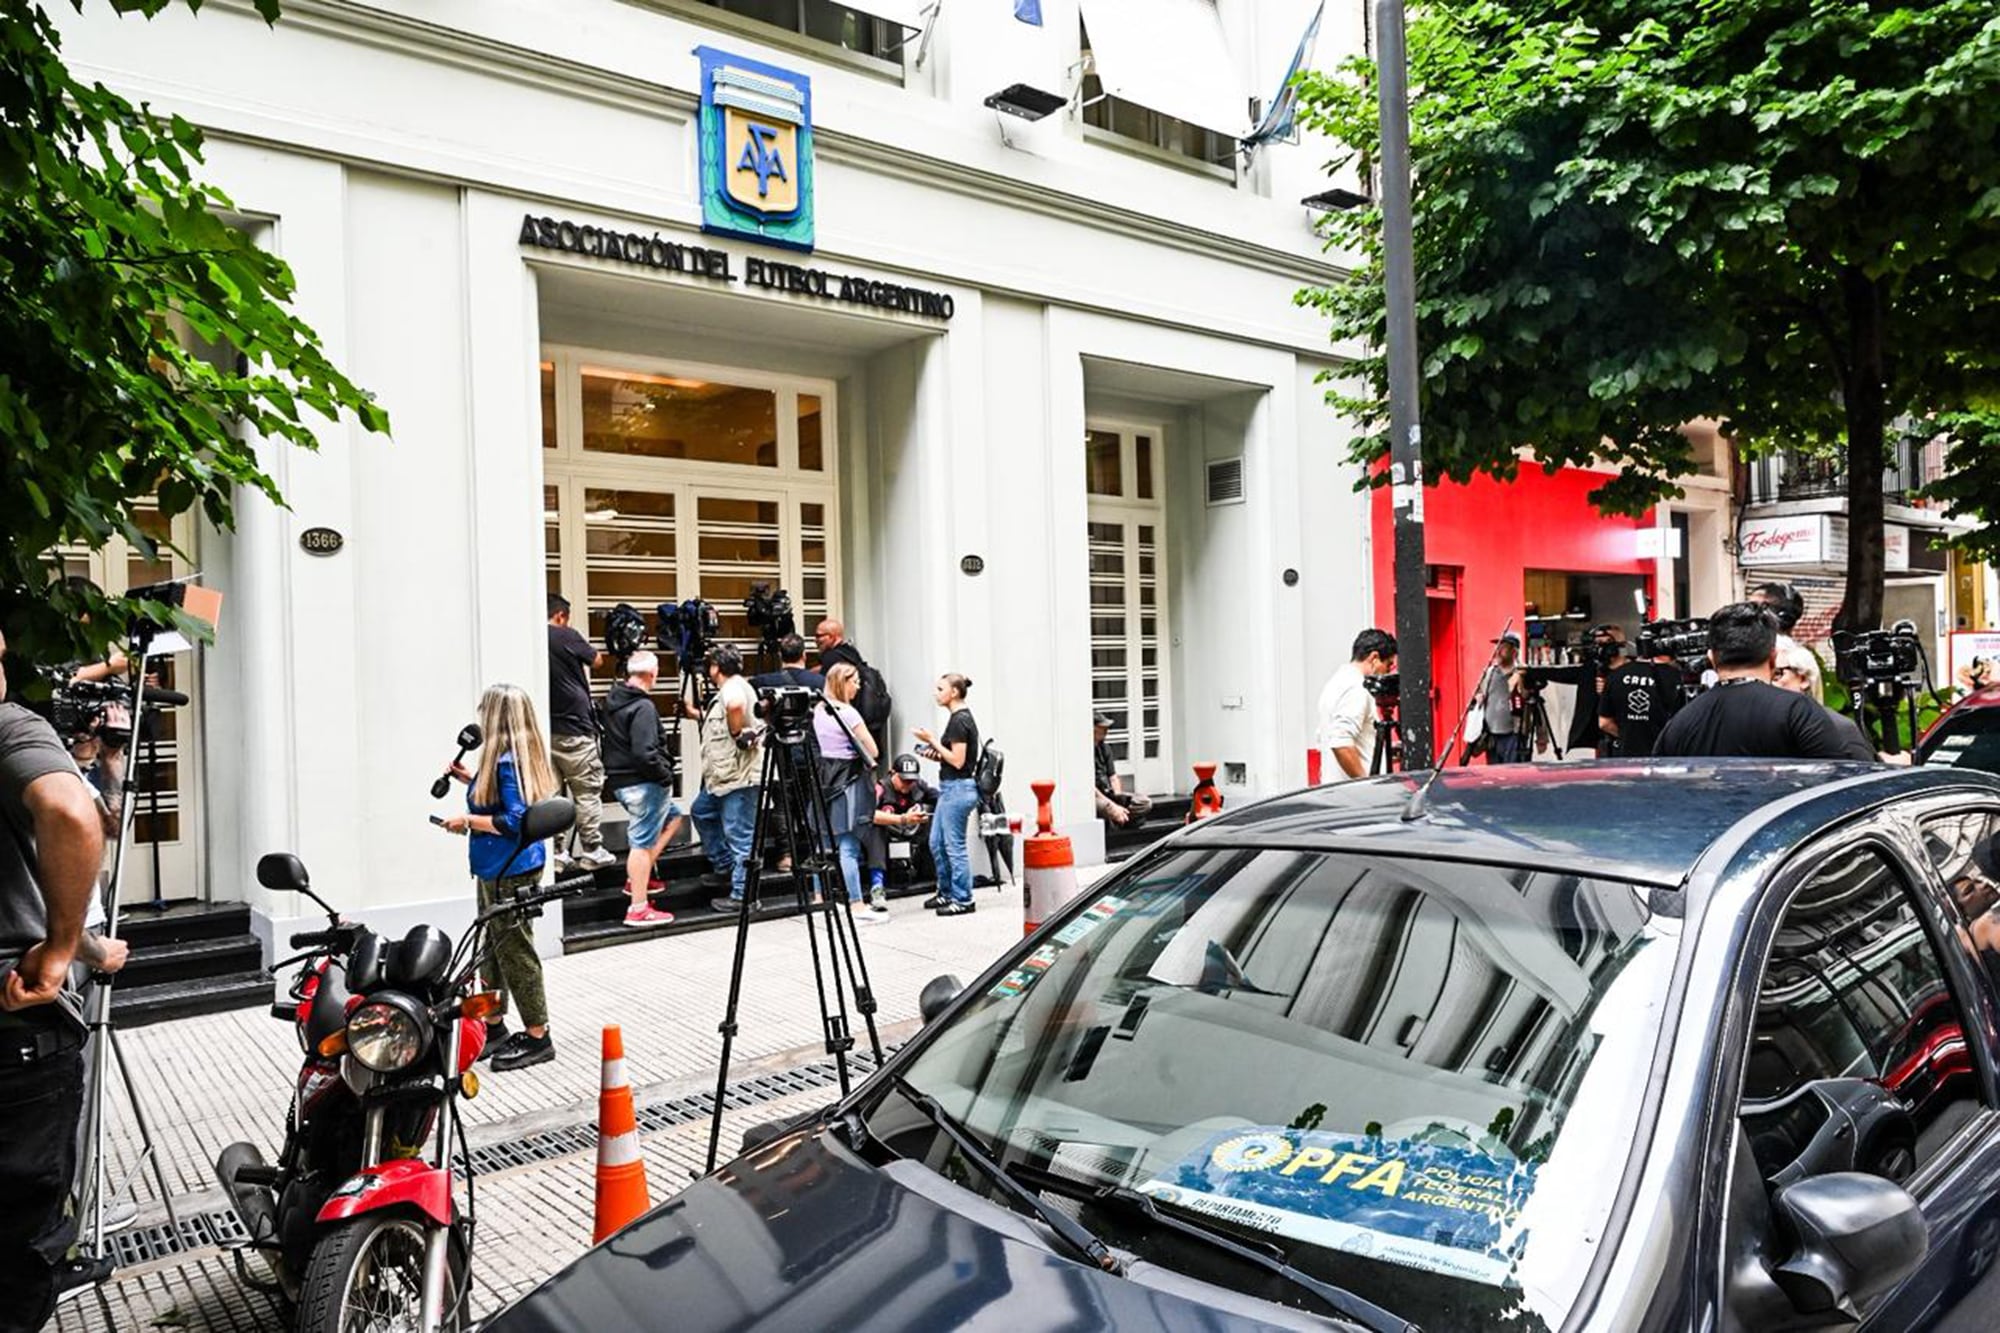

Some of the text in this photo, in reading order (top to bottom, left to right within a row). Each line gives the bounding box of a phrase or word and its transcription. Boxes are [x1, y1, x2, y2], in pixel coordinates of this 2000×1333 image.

[519, 213, 955, 320] ASOCIACIÓN DEL FUTBOL ARGENTINO
[306, 532, 338, 548] 1366
[1280, 1147, 1407, 1197] PFA
[1412, 1177, 1507, 1203] FEDERAL
